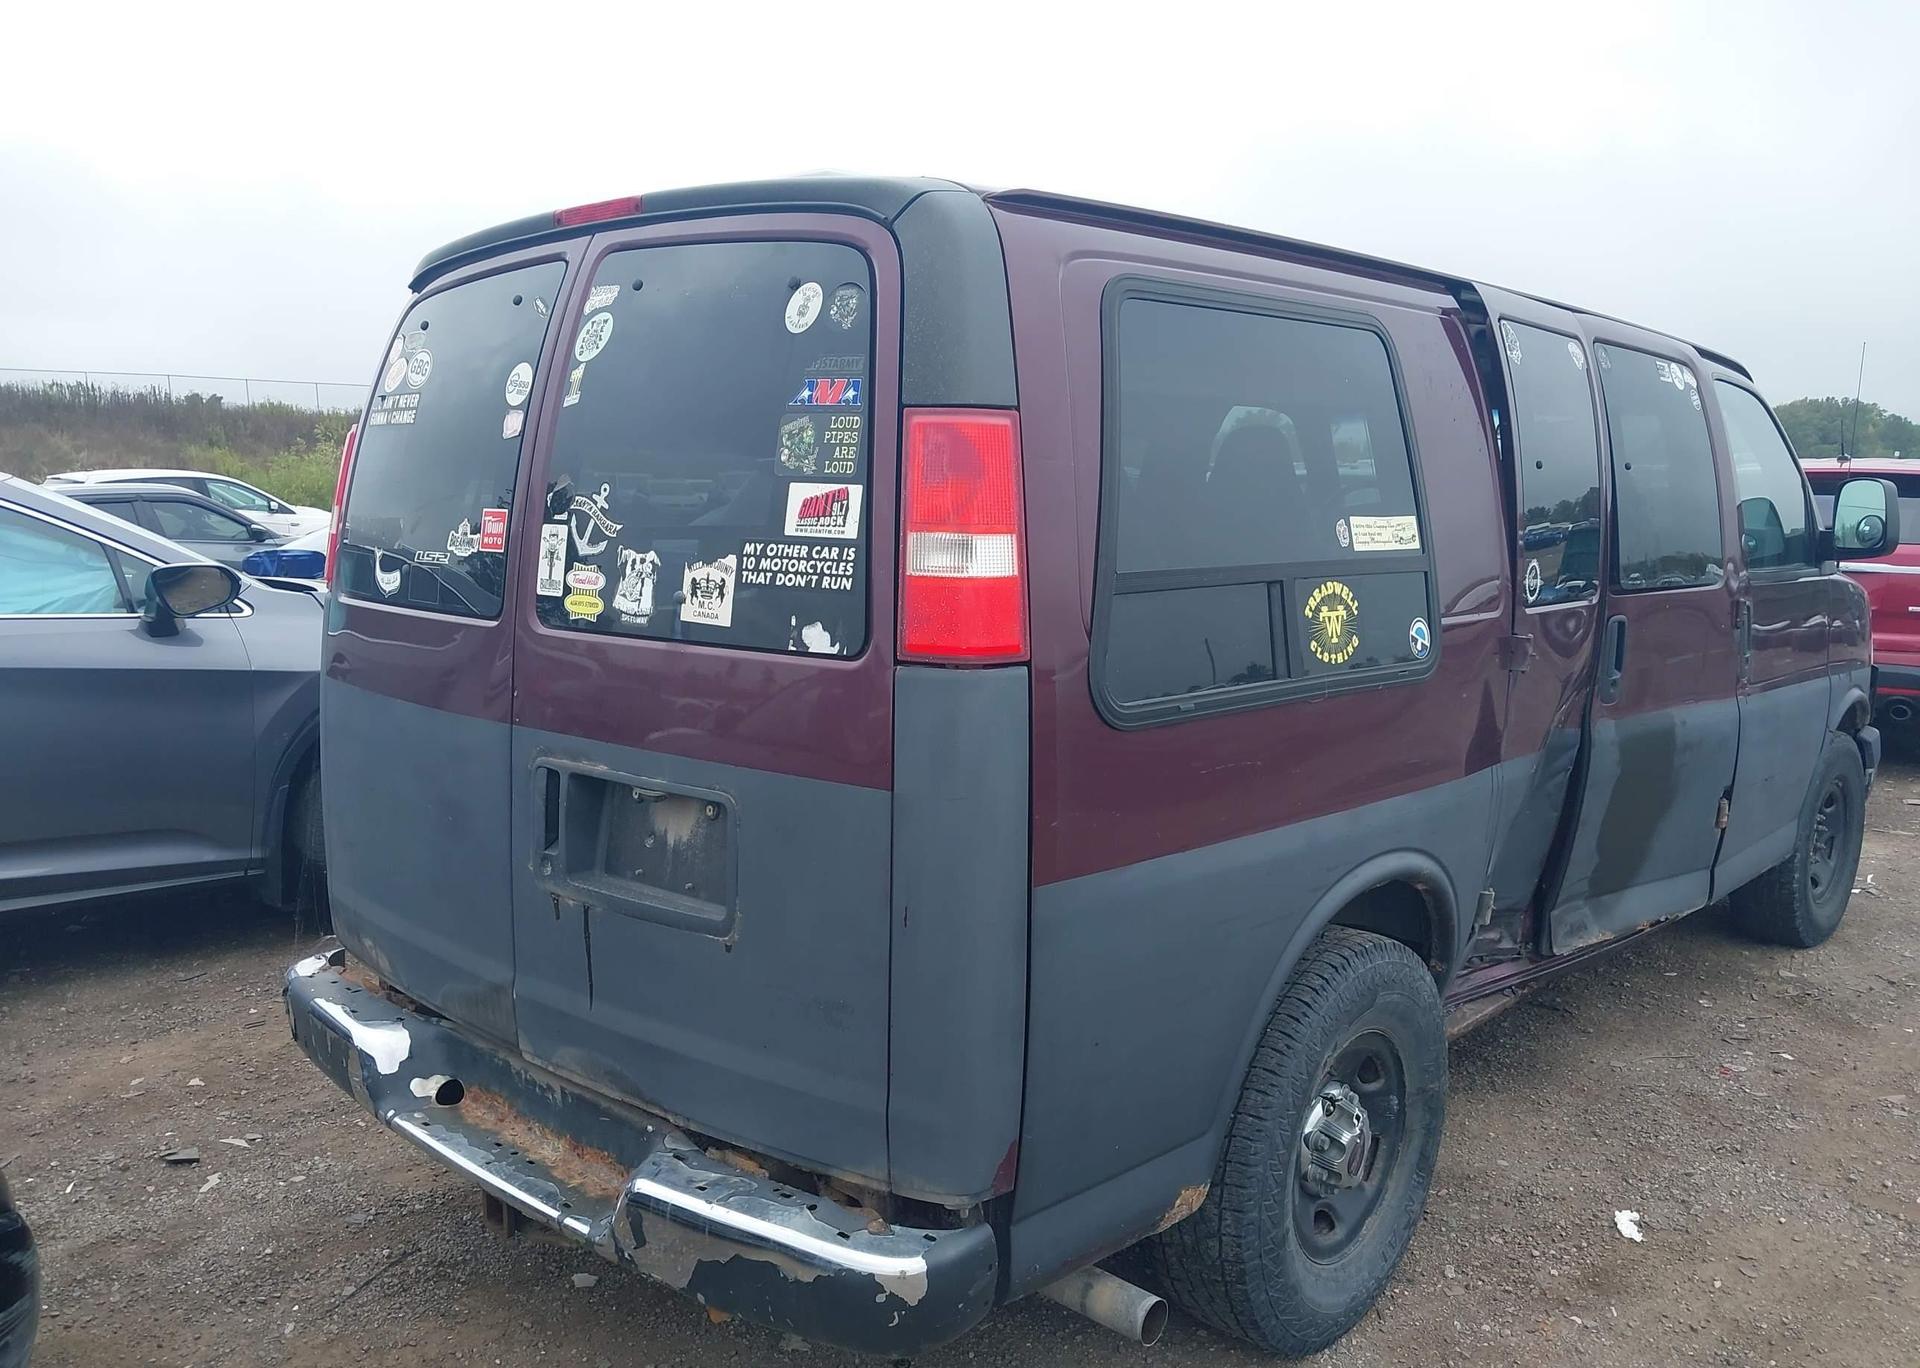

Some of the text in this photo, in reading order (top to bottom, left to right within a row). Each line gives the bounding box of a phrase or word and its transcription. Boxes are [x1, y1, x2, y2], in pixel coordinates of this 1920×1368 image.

[410, 357, 430, 377] GBG
[789, 378, 862, 405] AMA
[398, 393, 420, 408] NEVER
[391, 409, 416, 424] CHANGE
[830, 416, 860, 428] LOUD
[824, 431, 858, 443] PIPES
[833, 446, 856, 459] ARE
[824, 461, 854, 473] LOUD
[574, 498, 593, 514] SANTA
[831, 500, 848, 516] 91.7
[818, 515, 846, 527] ROCK
[483, 537, 502, 545] MOTO
[416, 551, 450, 563] LS2
[743, 542, 856, 561] MY OTHER CAR IS
[742, 557, 853, 577] 10 MOTORCYCLES
[742, 571, 853, 591] THAT DON'T RUN
[698, 600, 716, 611] M.C.
[1304, 580, 1359, 619] TREADWELL
[693, 610, 719, 620] CANADA
[1309, 634, 1360, 665] CLOTHING
